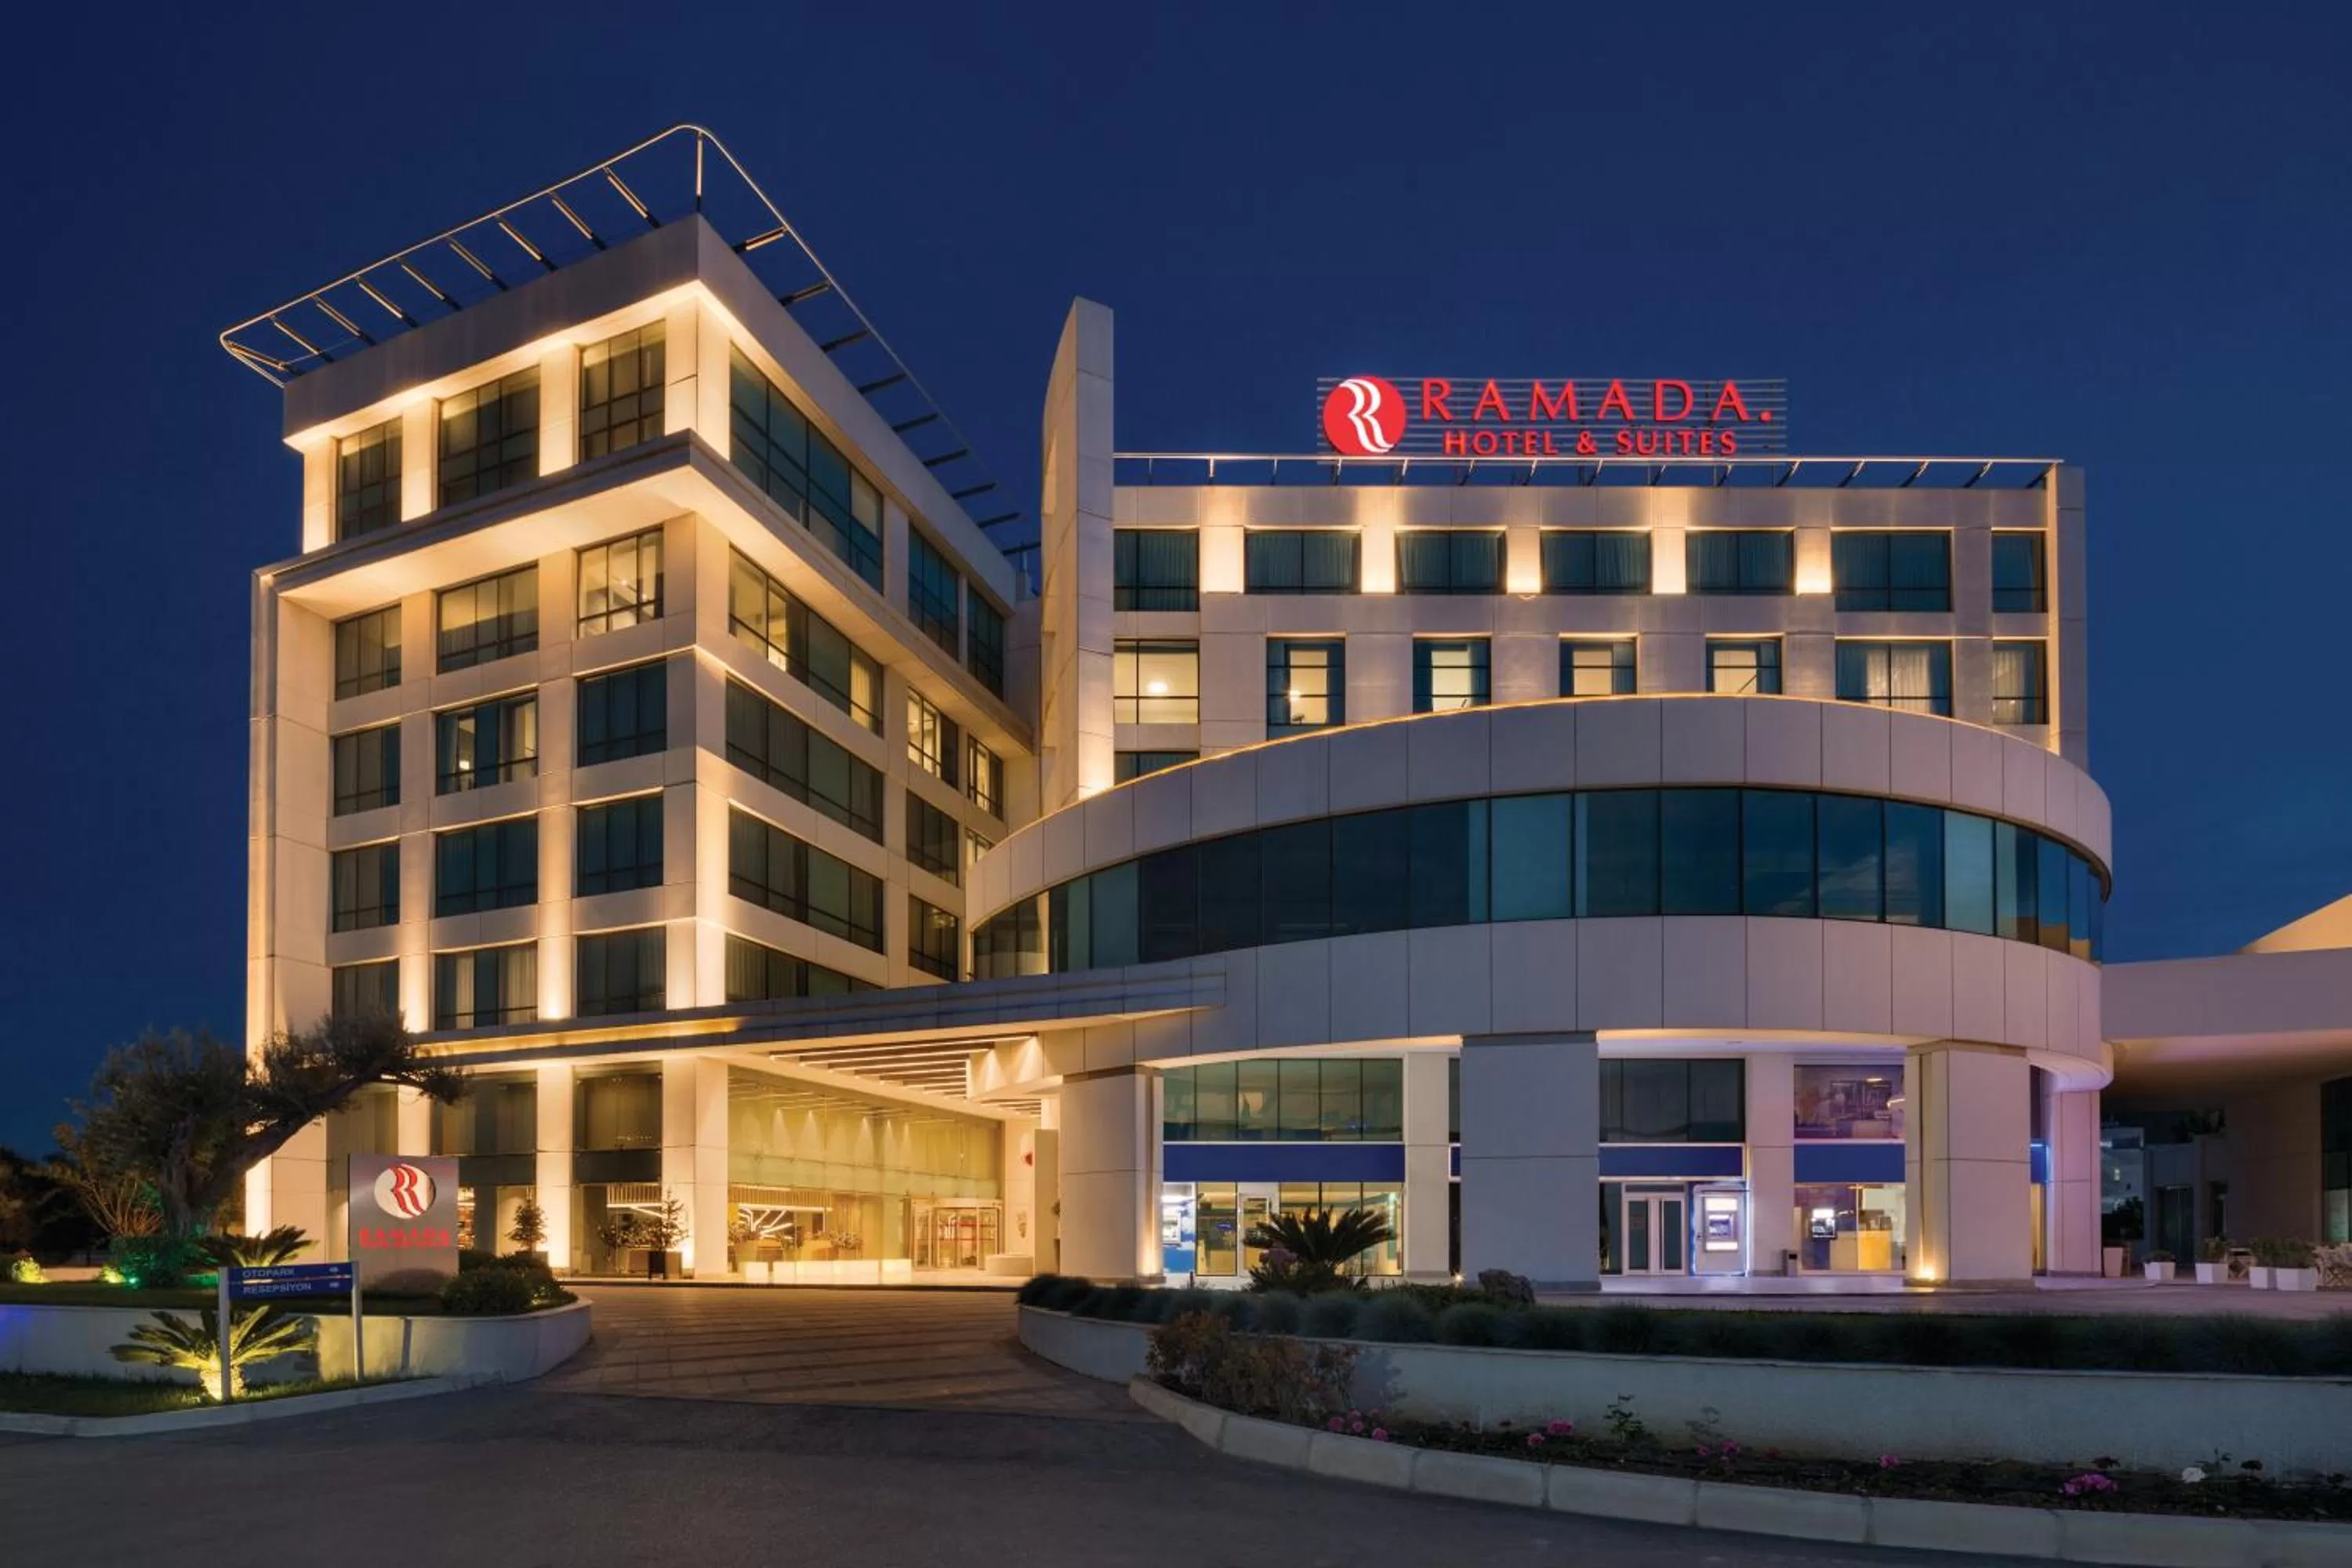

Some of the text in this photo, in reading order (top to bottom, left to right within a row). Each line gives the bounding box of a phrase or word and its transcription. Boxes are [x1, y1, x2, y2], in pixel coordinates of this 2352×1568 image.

[1443, 430, 1737, 455] HOTEL & SUITES
[242, 1268, 296, 1279] OTOPARK
